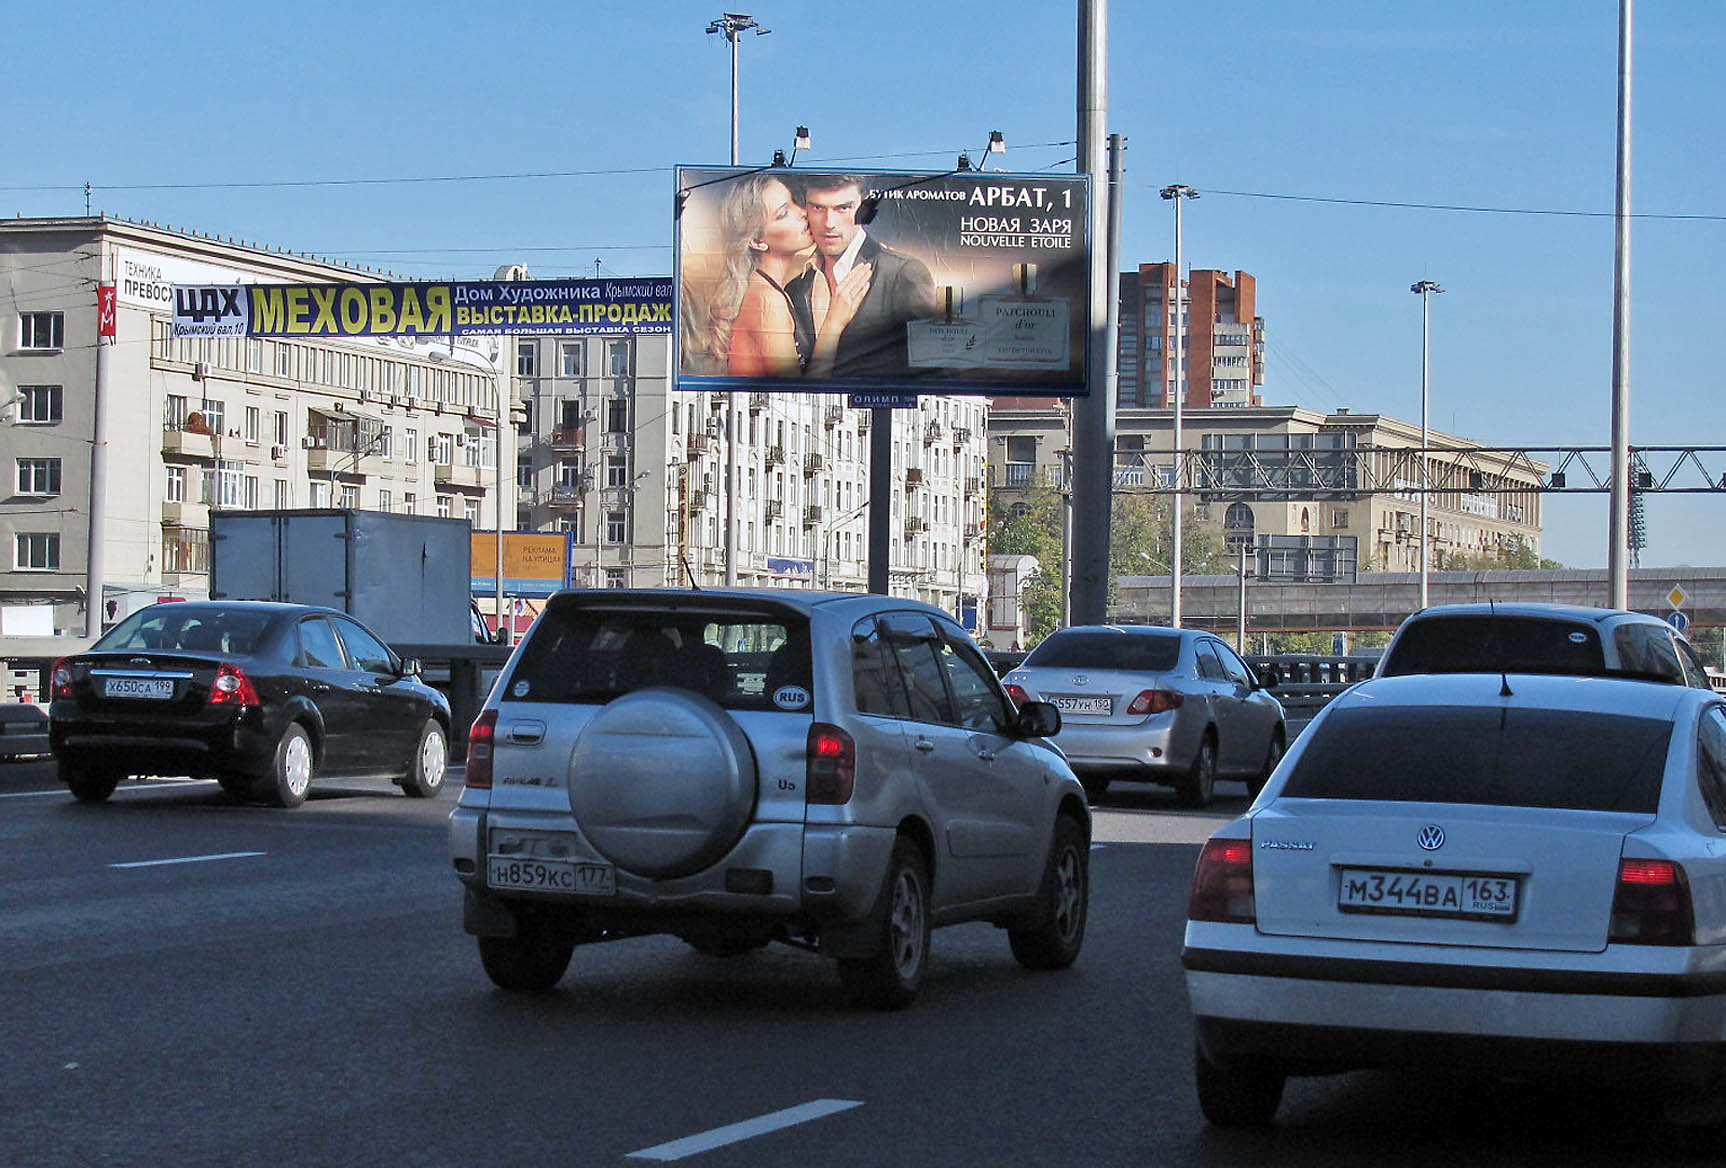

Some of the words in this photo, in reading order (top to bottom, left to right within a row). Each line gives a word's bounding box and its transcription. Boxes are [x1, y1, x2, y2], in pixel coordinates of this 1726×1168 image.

[907, 190, 966, 201] АРОМАТОВ
[969, 186, 1054, 212] АРБАТ,
[1062, 189, 1071, 208] 1
[961, 217, 1020, 233] НОВАЯ
[1030, 219, 1071, 233] ЗАРЯ
[961, 235, 1025, 247] NOUVELLE
[1031, 237, 1071, 248] ETOILE
[124, 261, 162, 279] ТЕХНИКА
[455, 285, 493, 304] Дом
[498, 285, 601, 304] Художника
[605, 282, 654, 299] Крымский
[176, 288, 242, 323] ЦДХ
[252, 286, 452, 334] МЕХОВАЯ
[996, 307, 1055, 318] PATCHOULI
[174, 322, 216, 338] Крымский
[461, 328, 502, 336] САМАЯ
[565, 326, 630, 335] ВЫСТАВКА
[632, 325, 671, 334] СЕЗОН
[854, 395, 899, 403] ОЛИМП
[779, 692, 805, 702] RUS
[497, 863, 573, 887] Н859КС
[1348, 875, 1458, 907] М344ВА
[1466, 880, 1507, 901] 163
